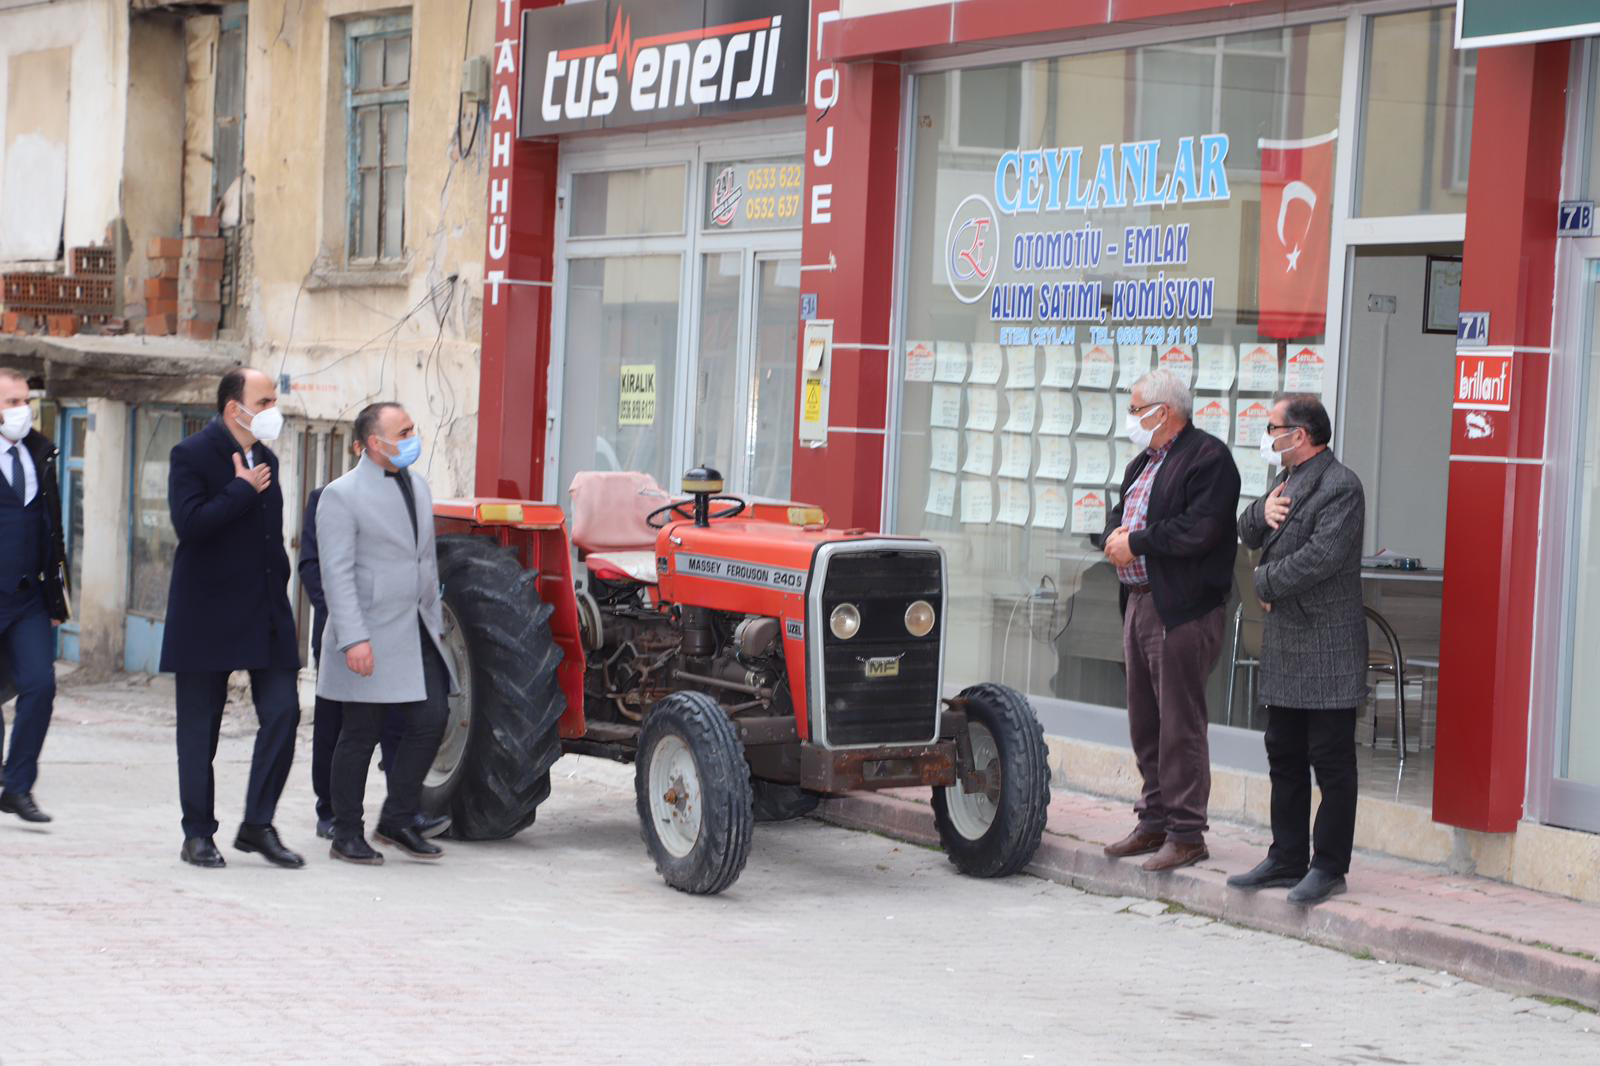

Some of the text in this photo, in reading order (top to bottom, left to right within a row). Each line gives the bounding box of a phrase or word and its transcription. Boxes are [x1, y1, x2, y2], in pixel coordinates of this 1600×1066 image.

[994, 133, 1231, 216] CEYLANLAR
[1013, 221, 1103, 272] OTOMOTİV
[1123, 223, 1190, 267] EMLAK
[990, 270, 1215, 324] ALIM SATIMI, KOMİSYON
[688, 557, 721, 574] MASSEY
[726, 565, 769, 582] FERGUSON
[869, 662, 896, 674] MF
